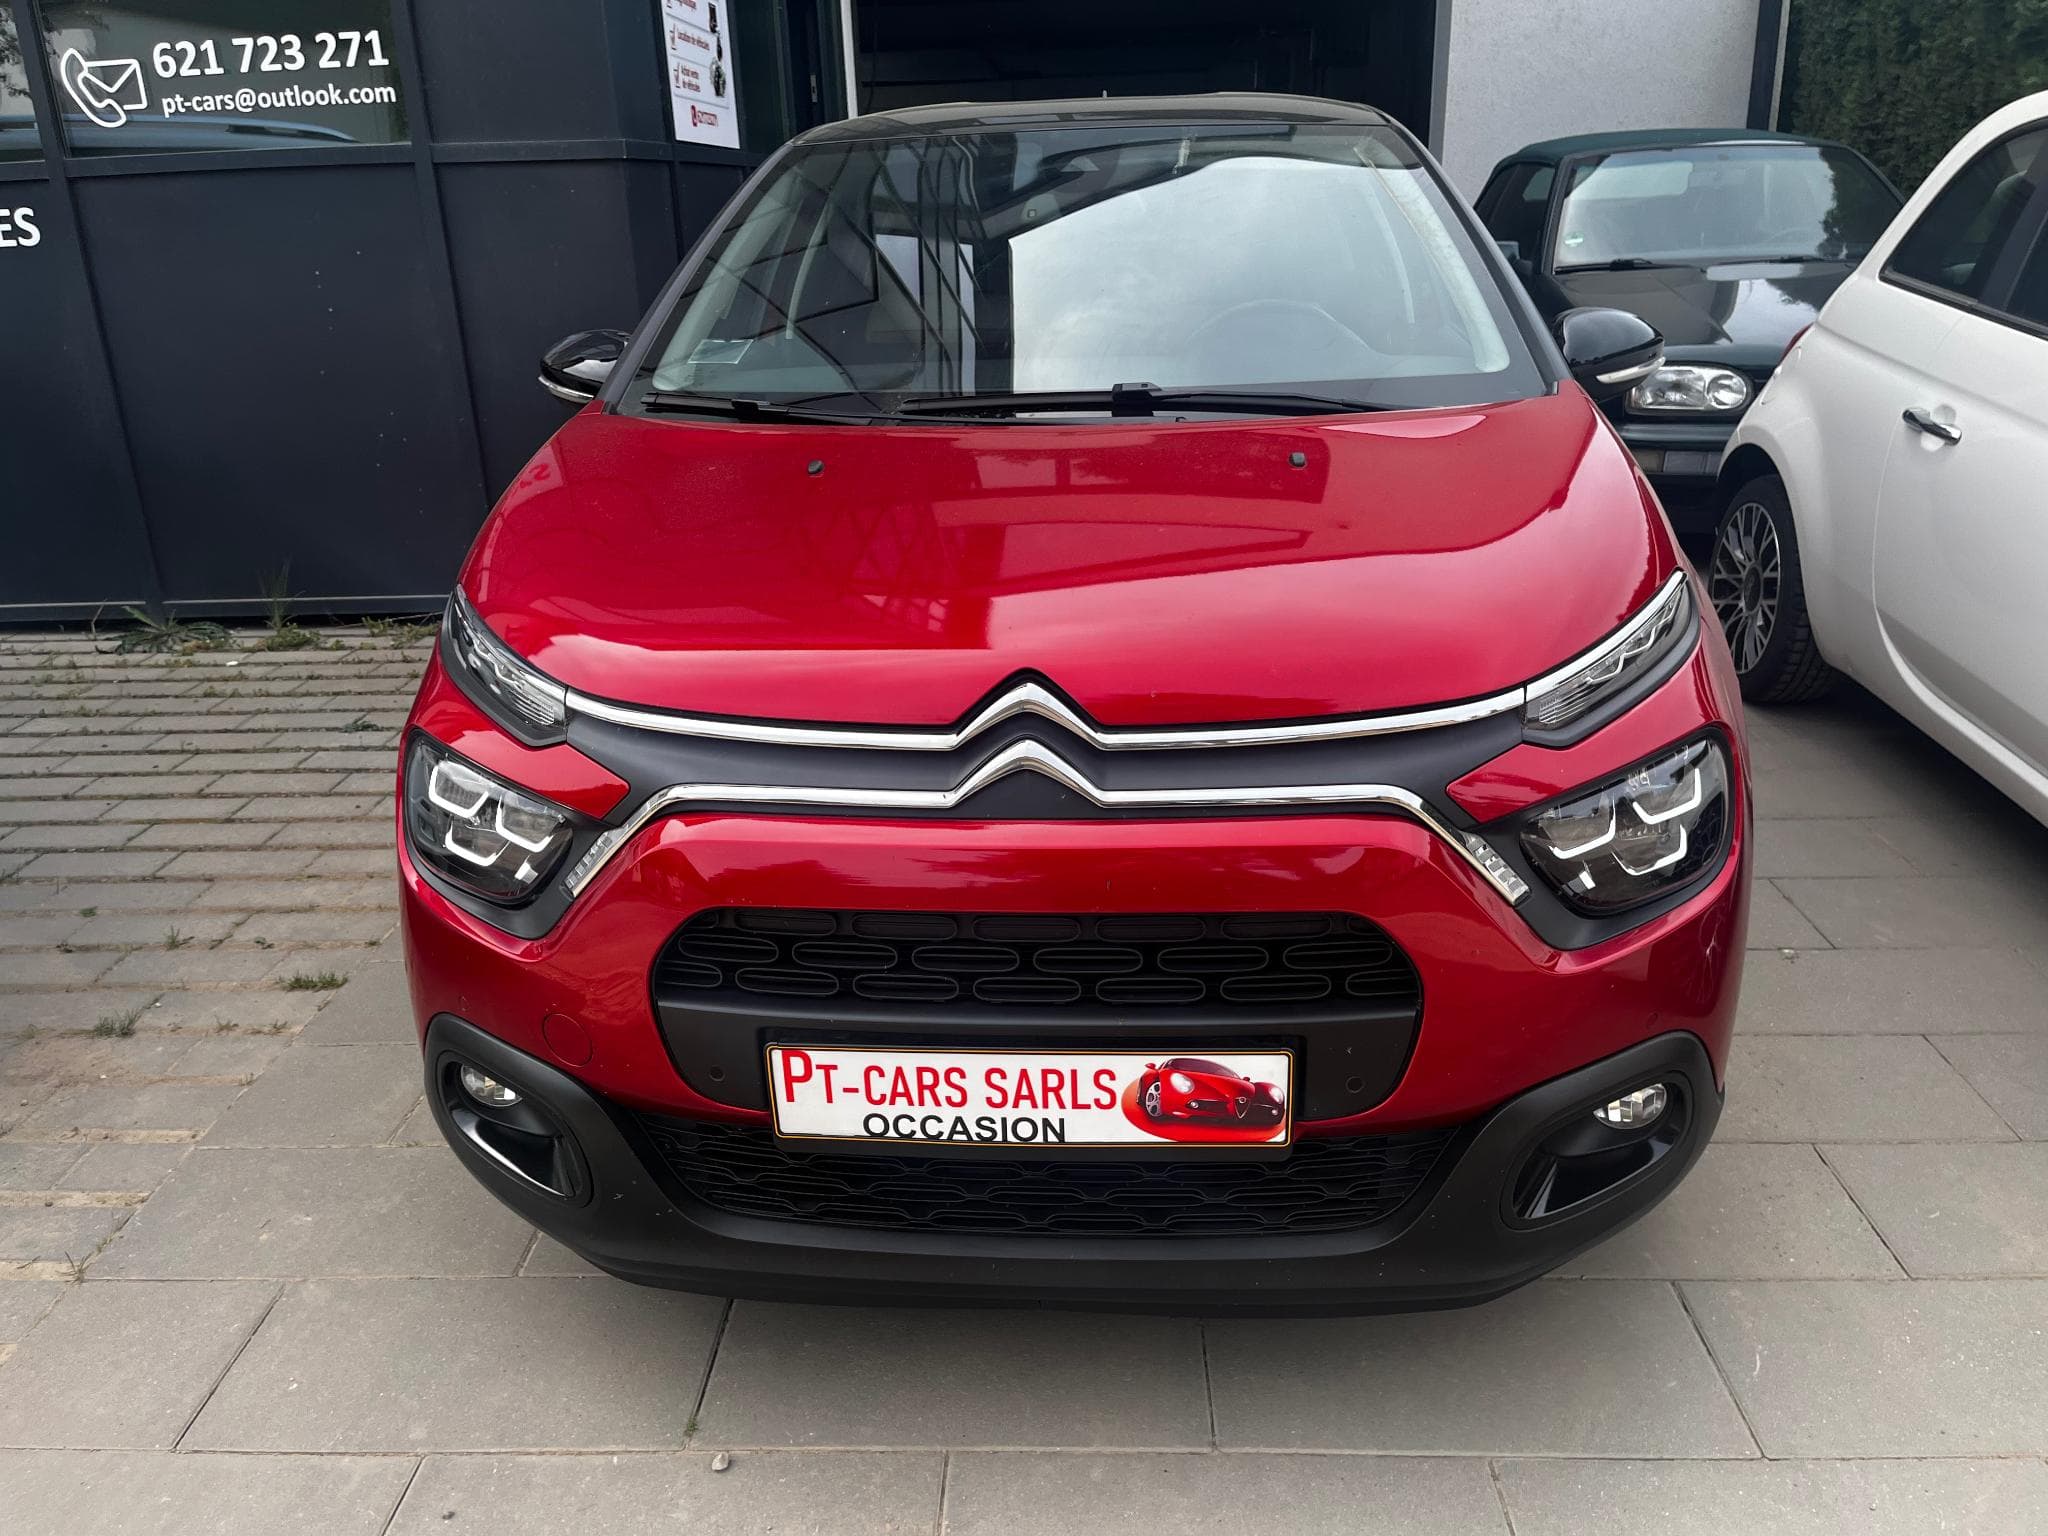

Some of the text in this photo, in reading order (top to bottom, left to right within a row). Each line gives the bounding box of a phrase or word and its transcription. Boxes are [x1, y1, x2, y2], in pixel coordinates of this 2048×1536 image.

[153, 30, 389, 78] 621 723 271
[162, 83, 397, 118] pt-cars@outlook.com
[984, 1067, 1117, 1110] SARLS
[863, 1113, 1066, 1143] OCCASION
